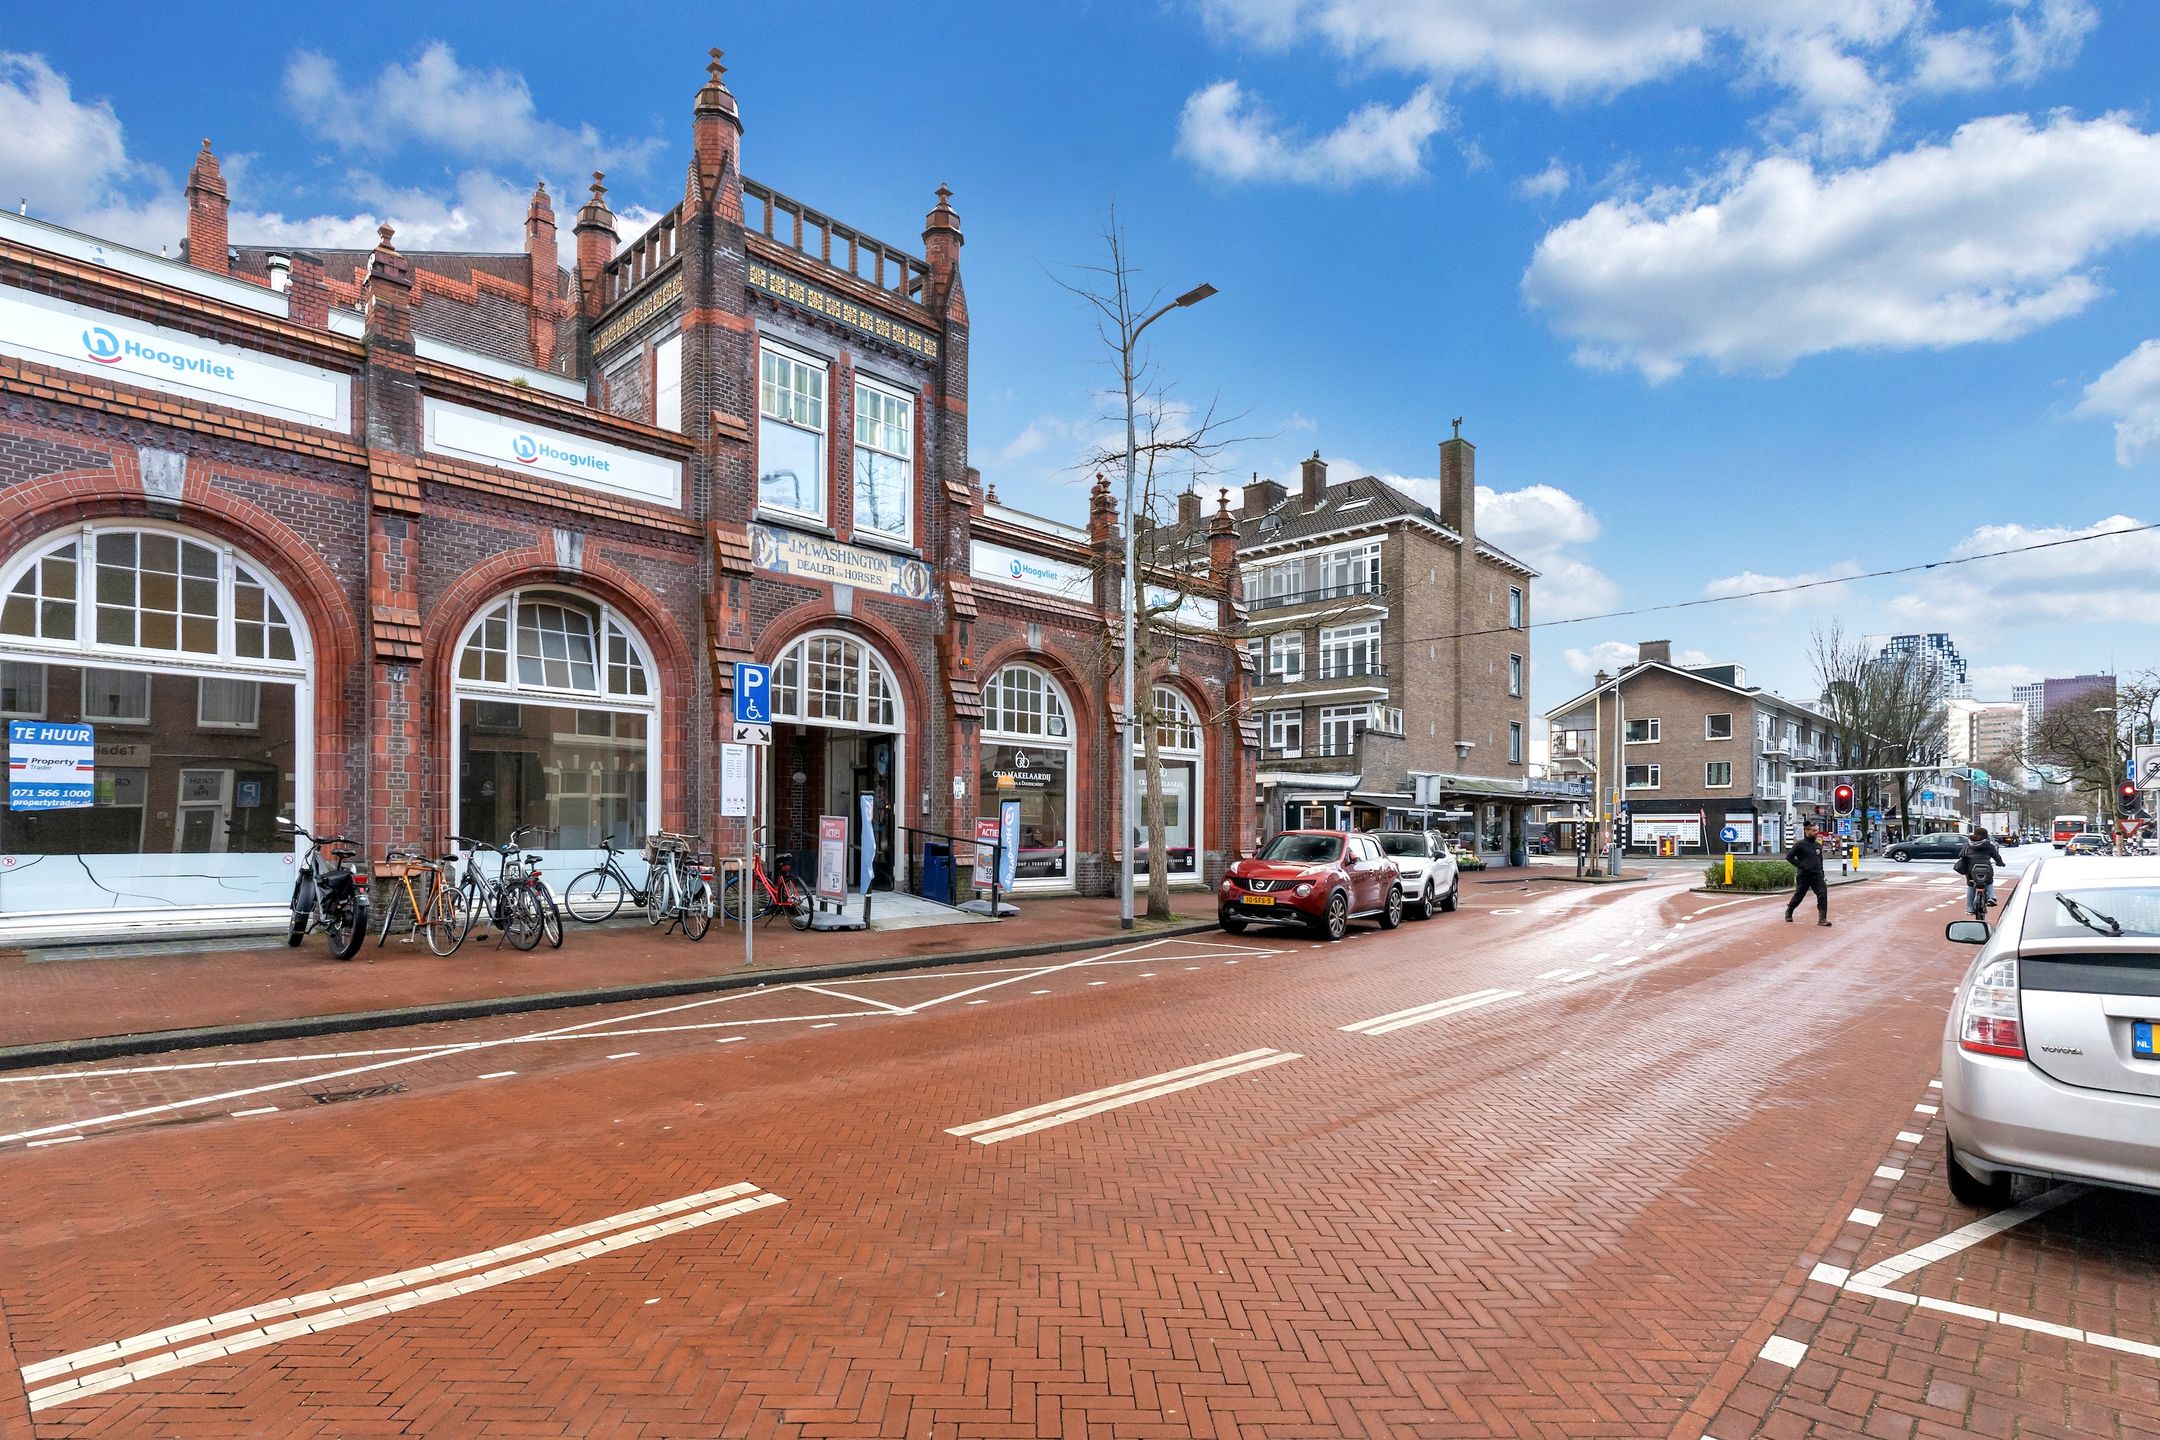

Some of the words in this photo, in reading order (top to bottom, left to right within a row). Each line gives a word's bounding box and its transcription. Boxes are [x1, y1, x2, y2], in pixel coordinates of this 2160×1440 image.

[125, 340, 235, 380] Hoogvliet
[539, 443, 610, 471] Hoogvliet
[797, 559, 835, 576] DEALER
[845, 569, 884, 585] HORSES.
[1023, 564, 1057, 580] Hoogvliet
[744, 667, 763, 698] P
[14, 727, 36, 739] TE
[40, 728, 90, 742] HUUR
[31, 757, 75, 766] Property
[1007, 771, 1051, 782] MAKELAARDIJ
[12, 788, 34, 797] 071
[37, 789, 60, 797] 566
[62, 790, 91, 798] 1000
[982, 828, 999, 837] ACTIE
[2041, 1045, 2083, 1056] TOYOTA
[2136, 1040, 2150, 1048] NL
